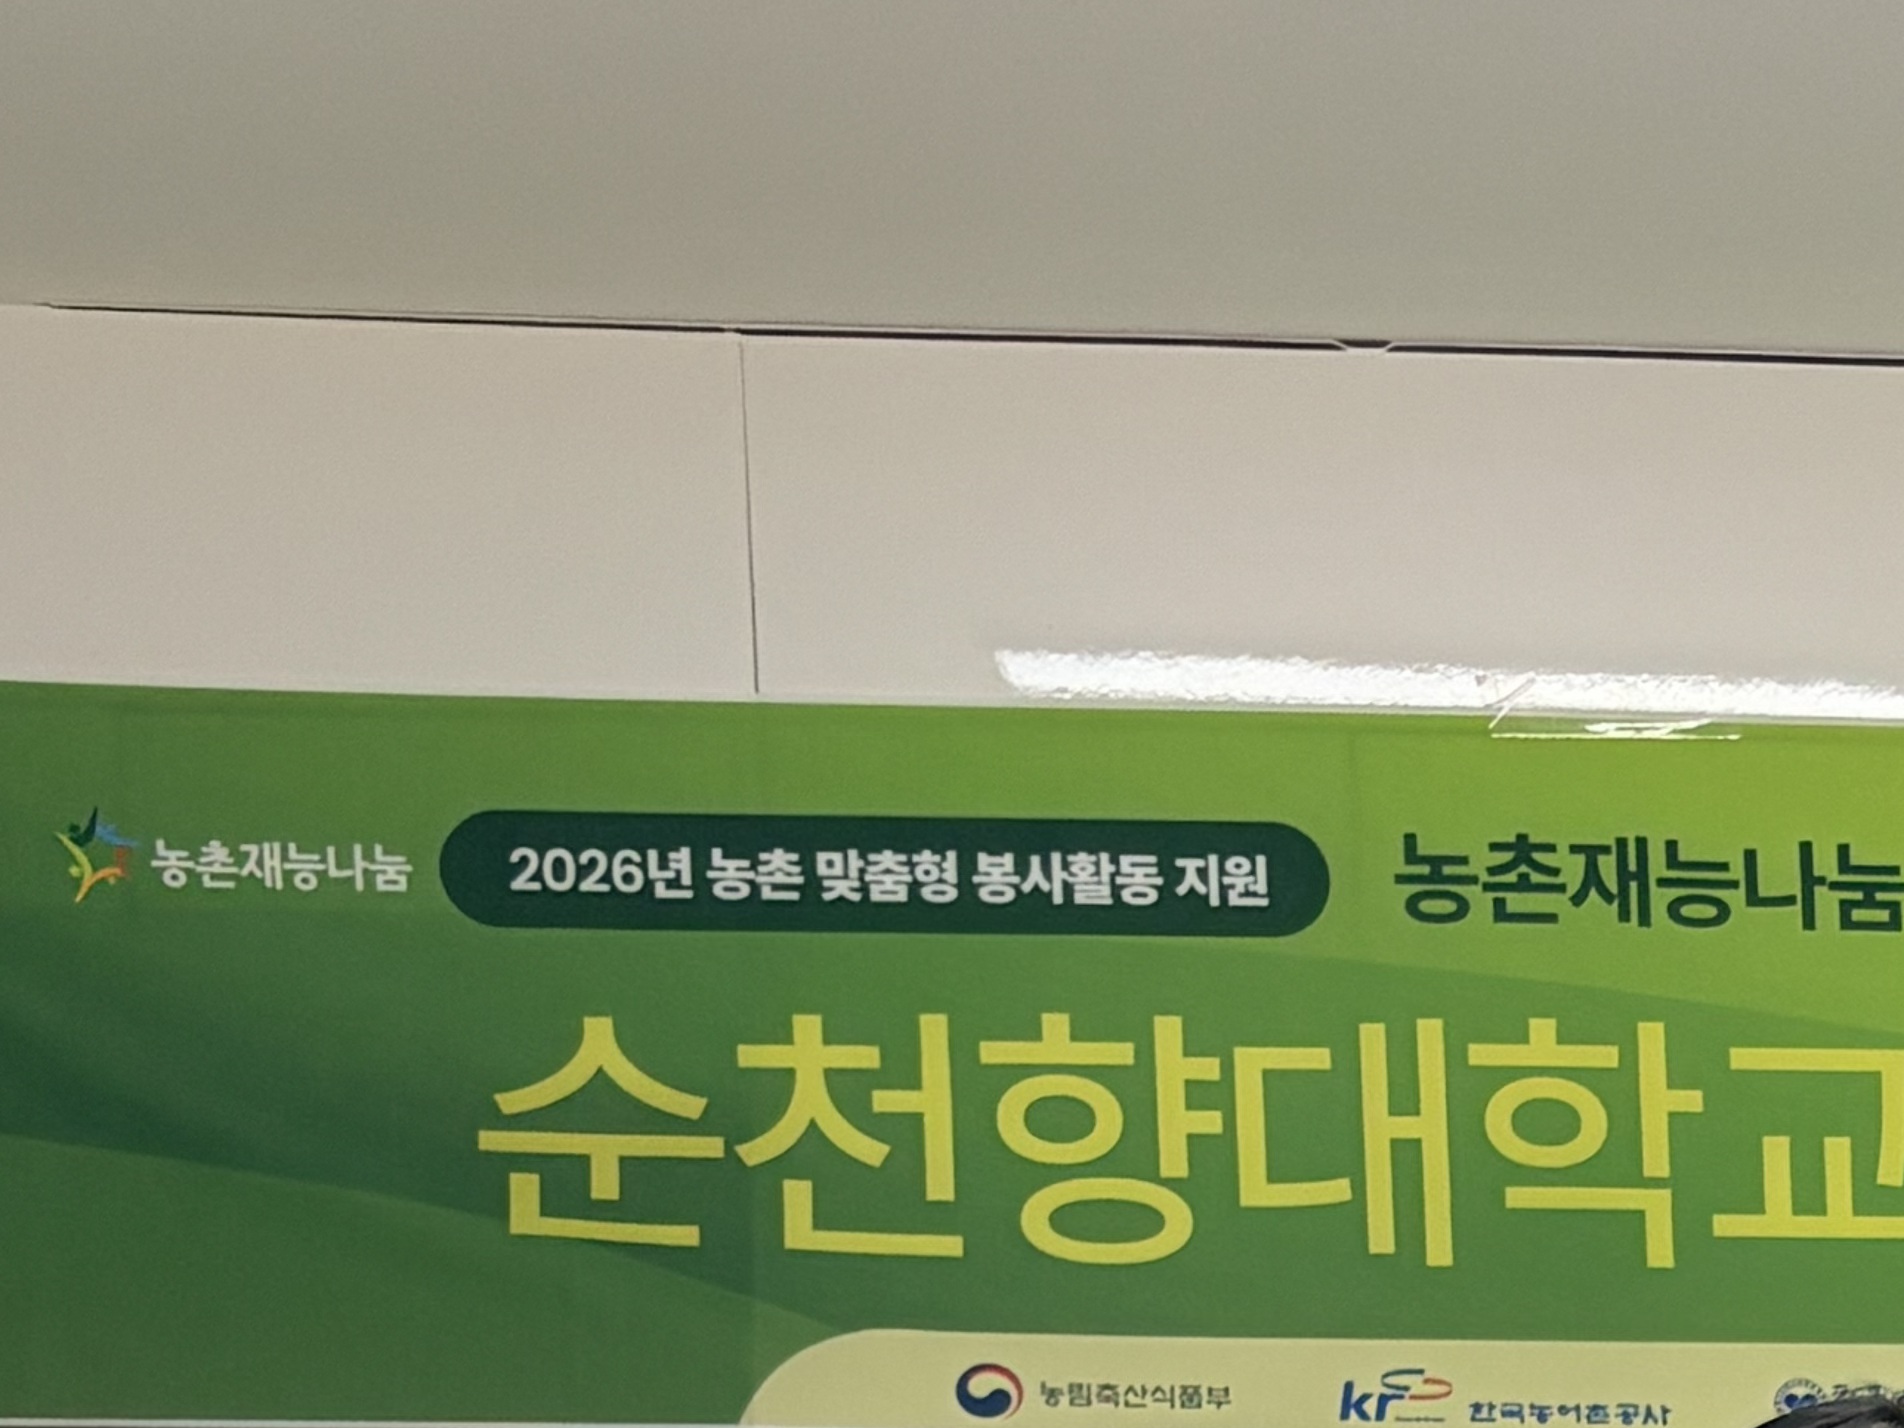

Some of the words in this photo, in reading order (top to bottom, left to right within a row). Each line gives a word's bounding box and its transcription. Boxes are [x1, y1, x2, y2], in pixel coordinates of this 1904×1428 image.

[150, 838, 414, 894] 농촌재능나눔
[509, 845, 695, 900] 2026년
[705, 846, 805, 901] 농촌
[815, 848, 959, 905] 맞춤형
[971, 850, 1165, 906] 봉사활동
[1174, 853, 1271, 909] 지원
[1039, 1380, 1232, 1411] 농림축산식품부
[1467, 1399, 1673, 1428] 한국농어촌공사
